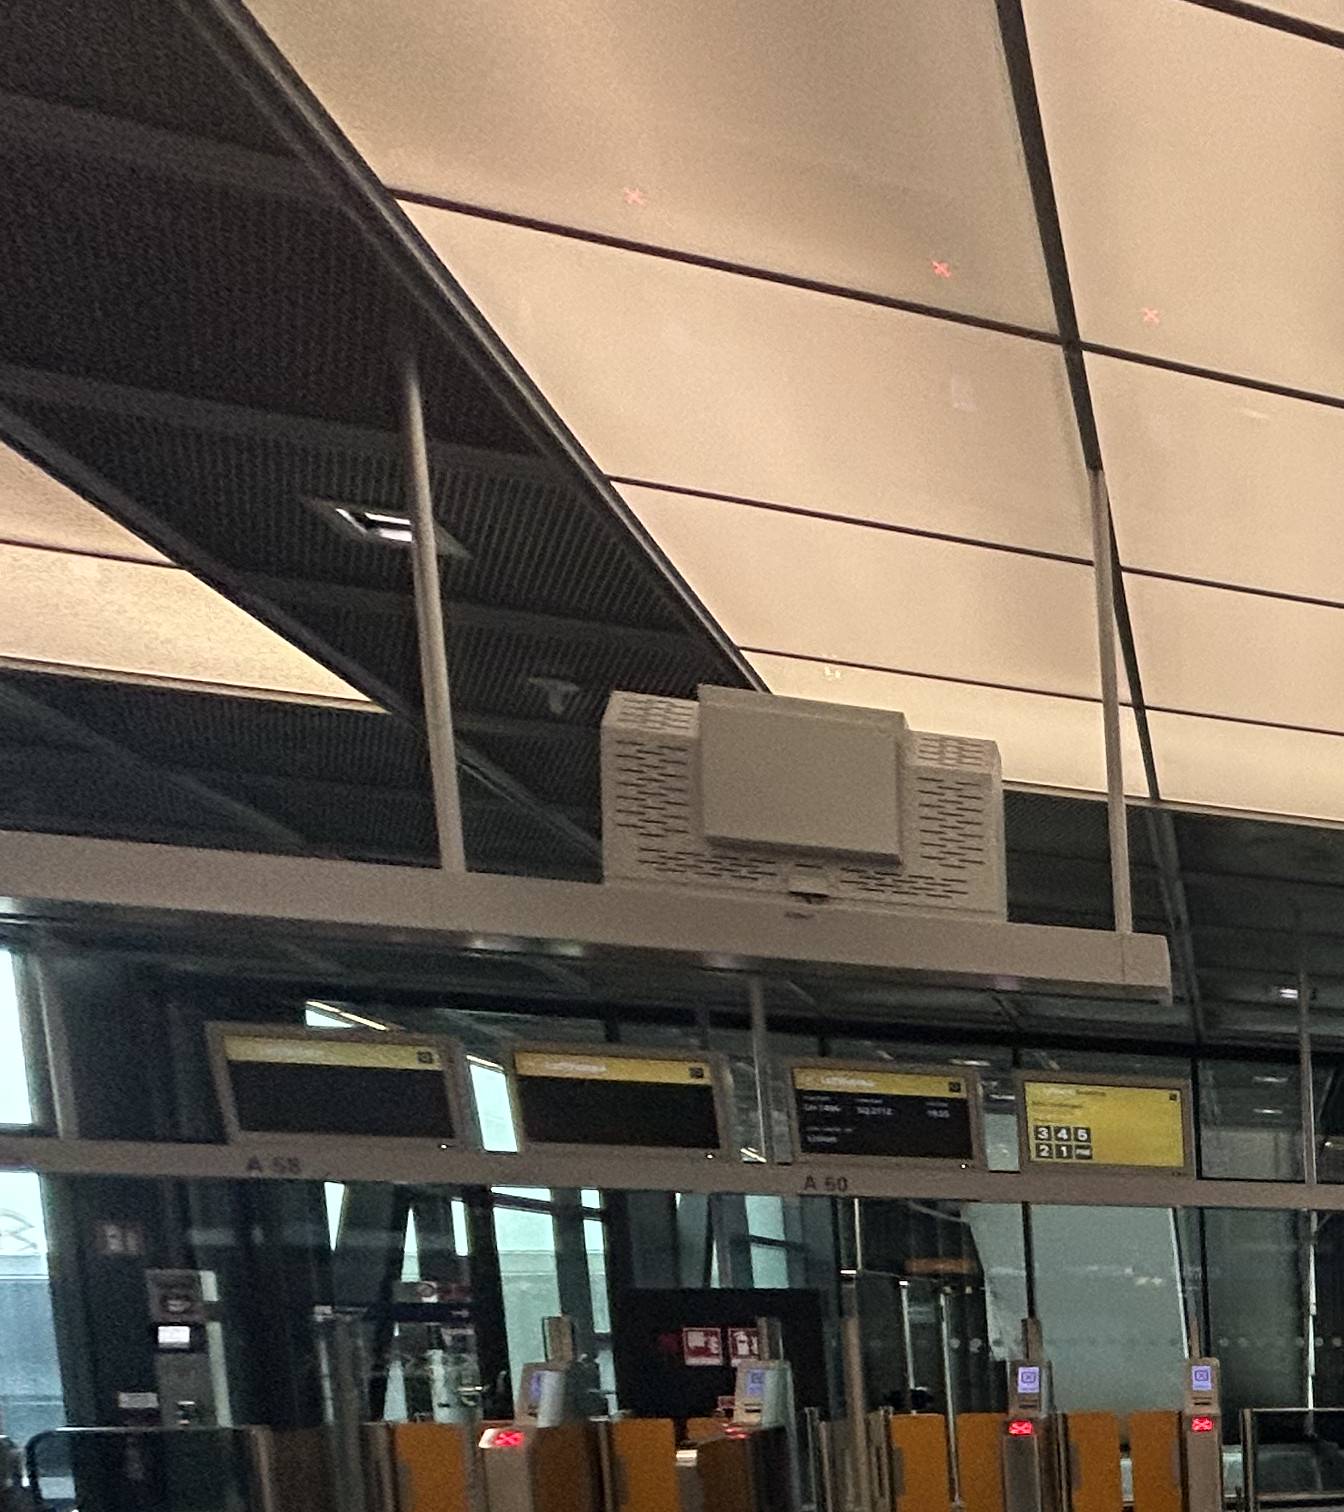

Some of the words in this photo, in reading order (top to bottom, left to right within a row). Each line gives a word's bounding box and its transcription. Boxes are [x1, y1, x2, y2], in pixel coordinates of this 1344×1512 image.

[1037, 1127, 1049, 1140] 3
[1057, 1128, 1069, 1141] 4
[1077, 1130, 1088, 1142] 5
[1039, 1145, 1051, 1158] 2
[246, 1154, 263, 1173] A
[804, 1174, 817, 1191] A
